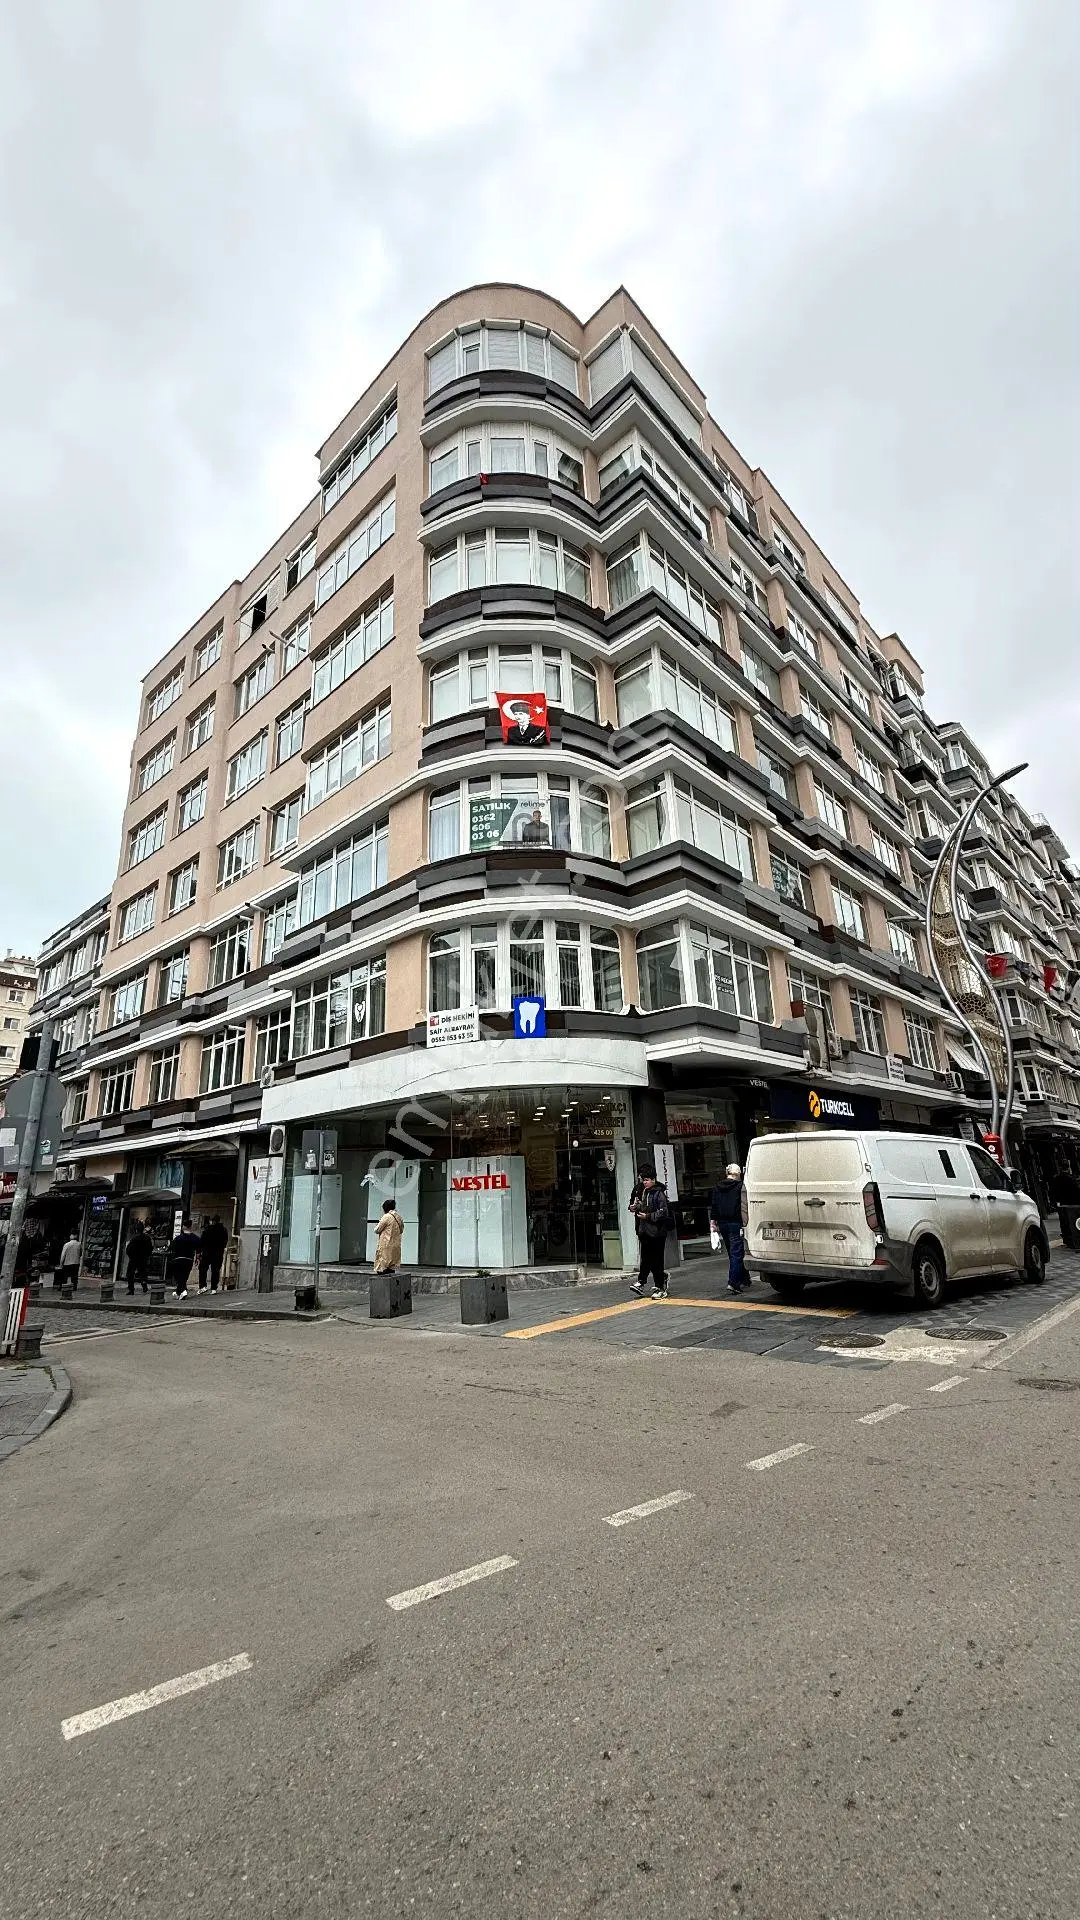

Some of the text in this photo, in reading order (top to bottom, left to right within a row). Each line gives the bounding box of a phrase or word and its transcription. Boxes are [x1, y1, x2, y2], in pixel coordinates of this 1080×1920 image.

[471, 802, 511, 813] SATILIK
[471, 813, 496, 824] 0362
[471, 823, 491, 832] 606
[471, 830, 500, 841] 03 06
[819, 1098, 855, 1117] TURKCELL
[452, 1174, 511, 1191] VESTEL
